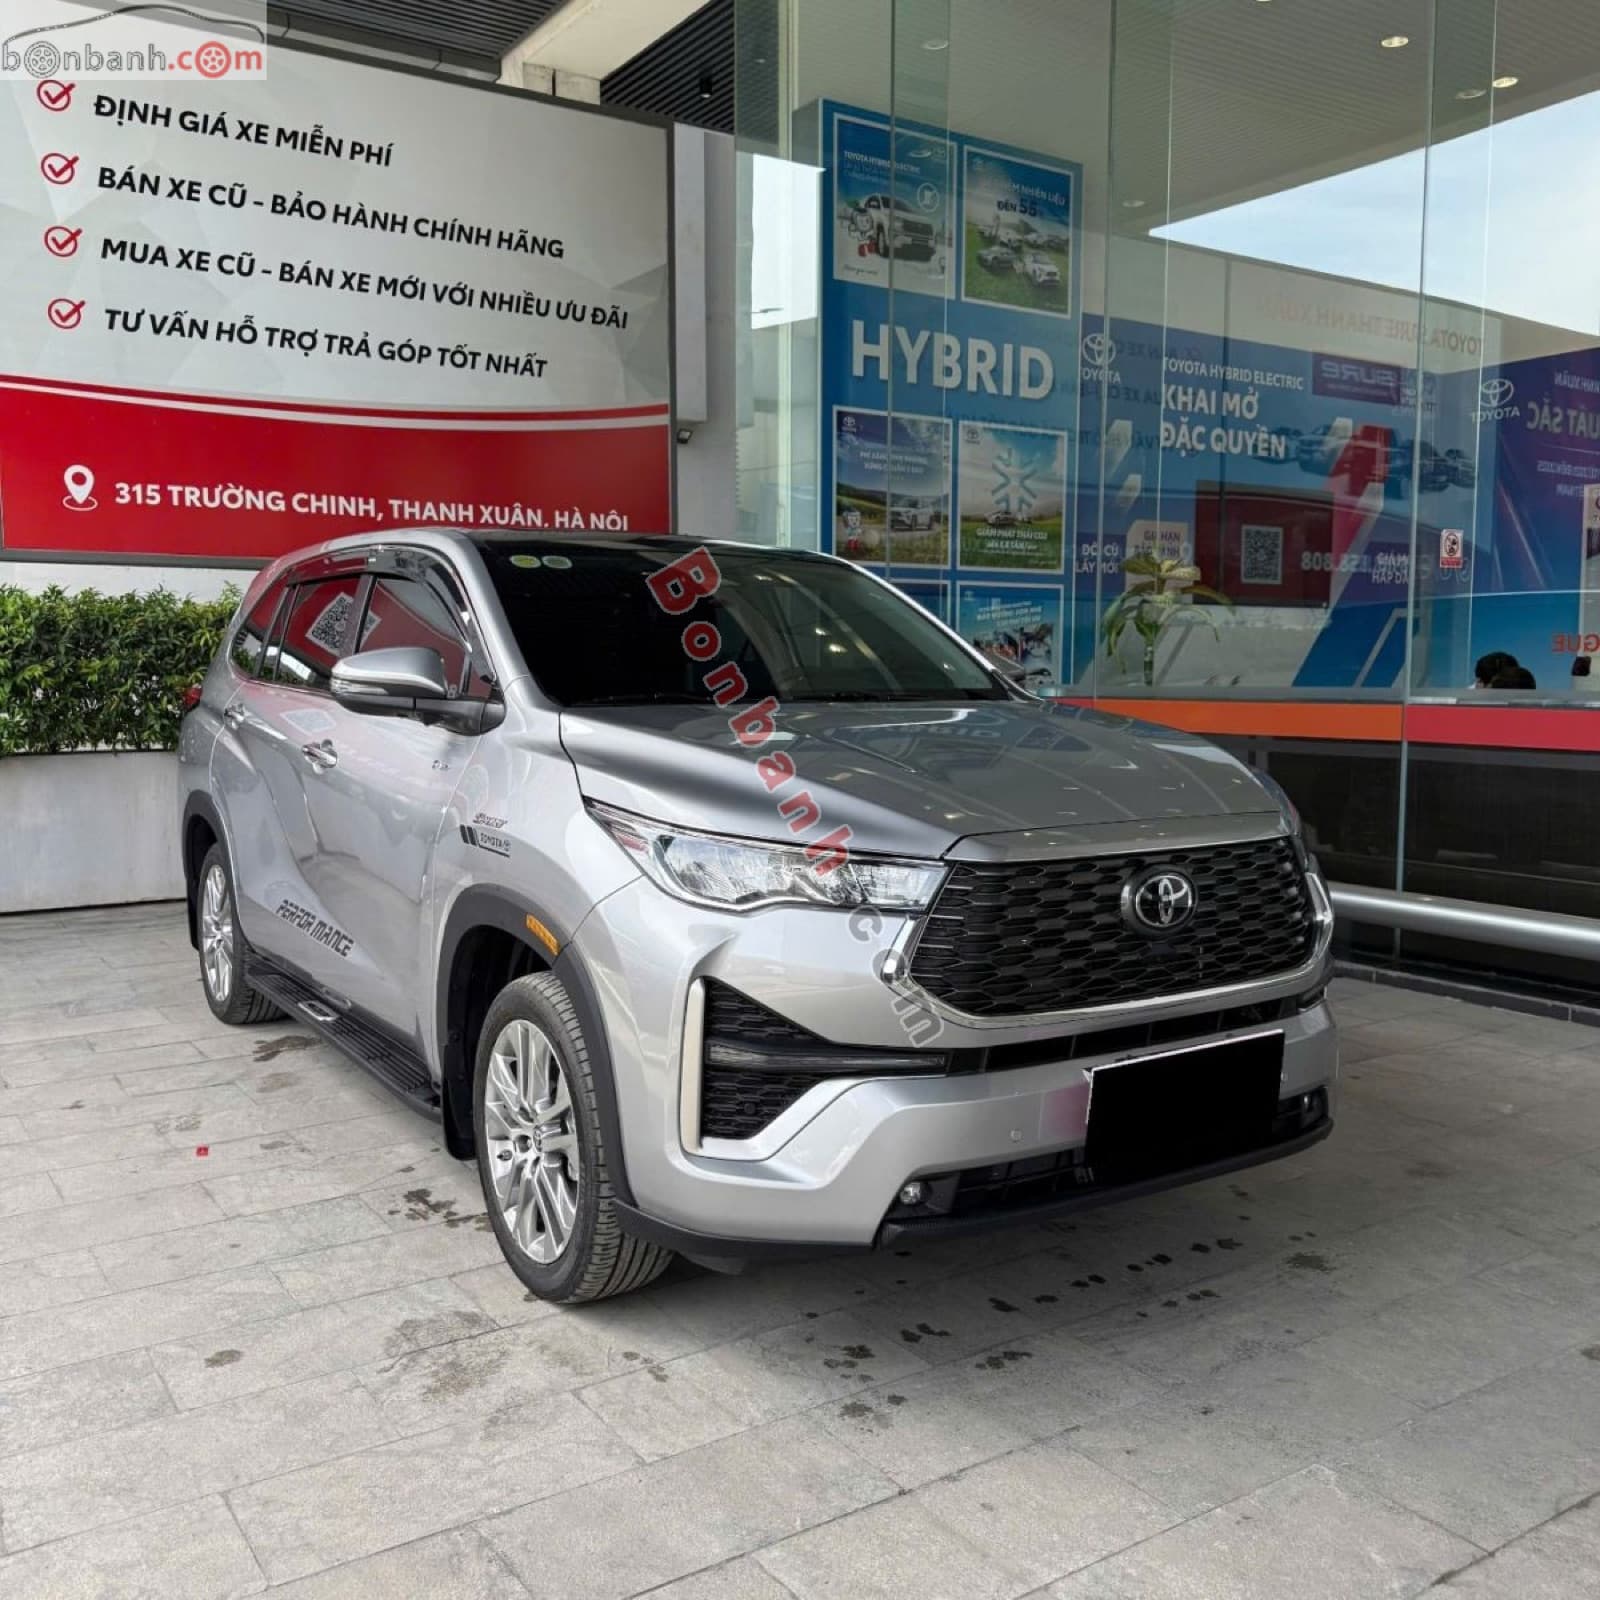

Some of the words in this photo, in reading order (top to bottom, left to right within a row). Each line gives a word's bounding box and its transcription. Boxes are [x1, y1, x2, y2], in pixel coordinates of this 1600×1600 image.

[93, 94, 172, 128] ĐỊNH
[178, 110, 229, 139] GIÁ
[234, 119, 270, 145] XE
[274, 123, 344, 159] MIỄN
[348, 140, 395, 167] PHÍ
[97, 164, 161, 197] BÁN
[165, 177, 203, 203] XE
[208, 182, 248, 209] CŨ
[270, 190, 327, 221] BẢO
[332, 202, 409, 235] HÀNH
[413, 217, 493, 248] CHÍNH
[496, 228, 565, 259] HÃNG
[100, 238, 169, 268] MUA
[175, 247, 212, 273] XE
[216, 251, 256, 278] CŨ
[278, 259, 335, 289] BÁN
[338, 270, 372, 294] XE
[376, 274, 427, 301] MỚI
[432, 281, 475, 308] VỚI
[479, 289, 551, 318] NHIỀU
[555, 299, 587, 323] ƯU
[590, 304, 629, 329] ĐÃI
[104, 308, 146, 333] TƯ
[148, 310, 209, 340] VẤN
[215, 314, 258, 345] HỖ
[264, 326, 319, 358] TRỢ
[323, 331, 372, 359] TRẢ
[377, 338, 433, 365] GÓP
[436, 343, 482, 370] TỐT
[485, 352, 549, 378] NHẤT
[851, 319, 1054, 401] HYBRID
[1162, 356, 1207, 377] TOYOTA
[1209, 359, 1253, 383] HYBRID
[1254, 370, 1304, 390] ELECTRIC
[1162, 383, 1216, 415] KHAI
[1222, 386, 1259, 420] MỞ
[1160, 416, 1206, 457] ĐẶC
[1210, 422, 1286, 459] QUYỀN
[114, 481, 161, 506] 315
[166, 482, 286, 512] TRƯỜNG
[291, 492, 384, 521] CHINH,
[388, 499, 474, 523] THANH
[554, 506, 585, 529] HÀ
